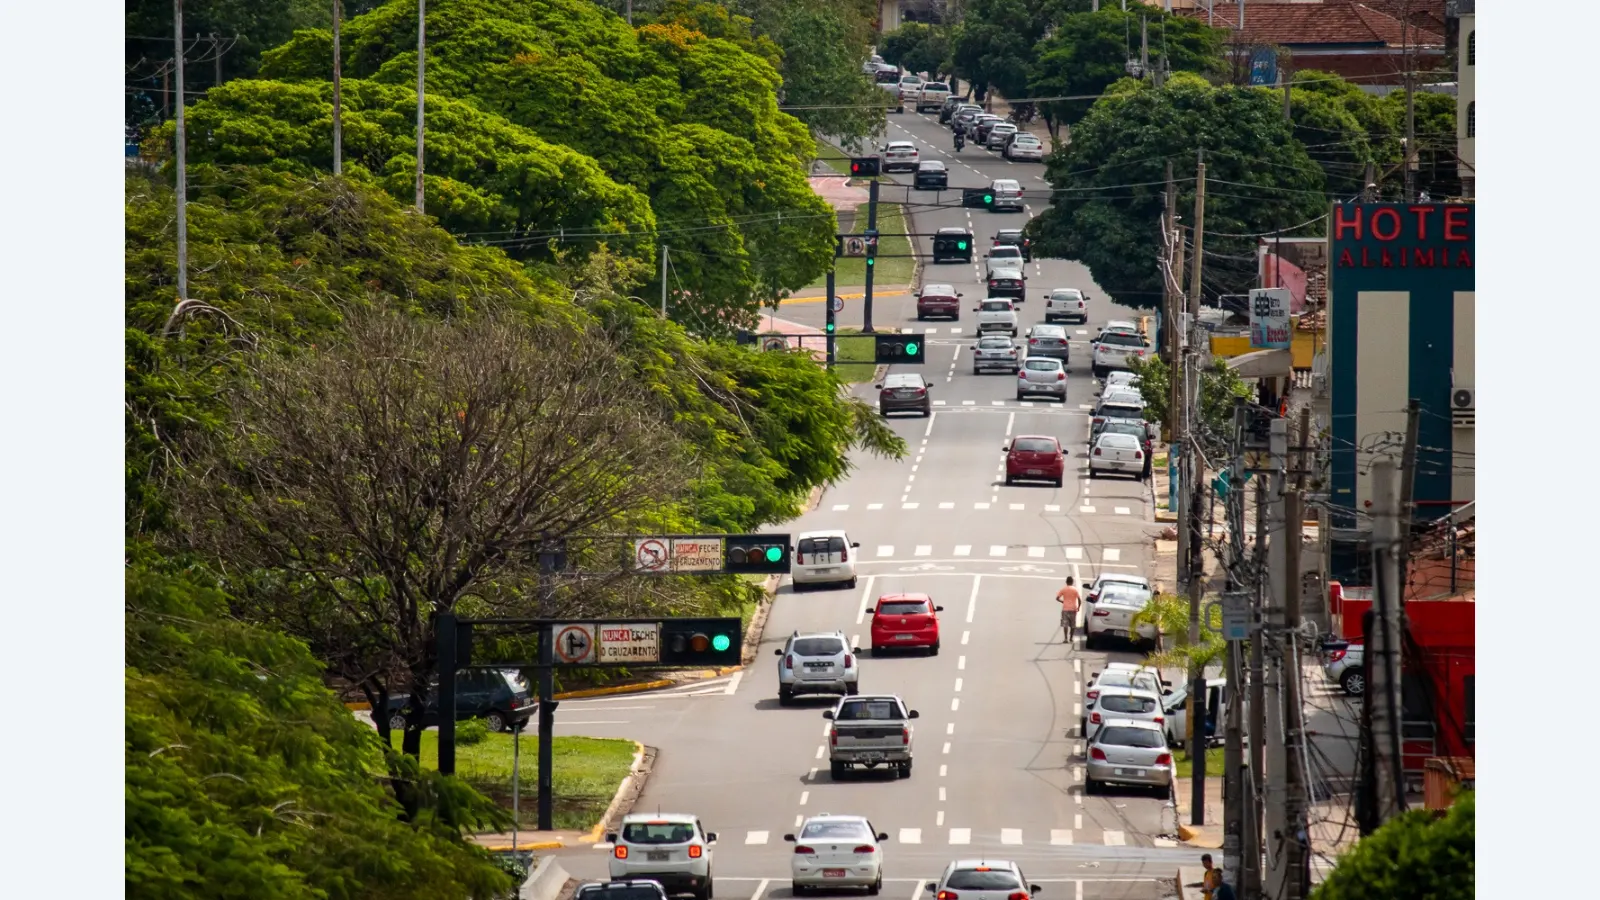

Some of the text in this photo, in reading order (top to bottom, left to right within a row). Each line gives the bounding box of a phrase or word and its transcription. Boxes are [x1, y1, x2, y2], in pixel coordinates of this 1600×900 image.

[1335, 207, 1469, 241] HOTE
[1338, 248, 1472, 267] ALKIMIA
[699, 544, 720, 553] FECHE
[679, 556, 721, 566] CRUZAMENTO
[602, 630, 630, 642] NUNCA
[601, 646, 657, 657] O CRUZAMENTO
